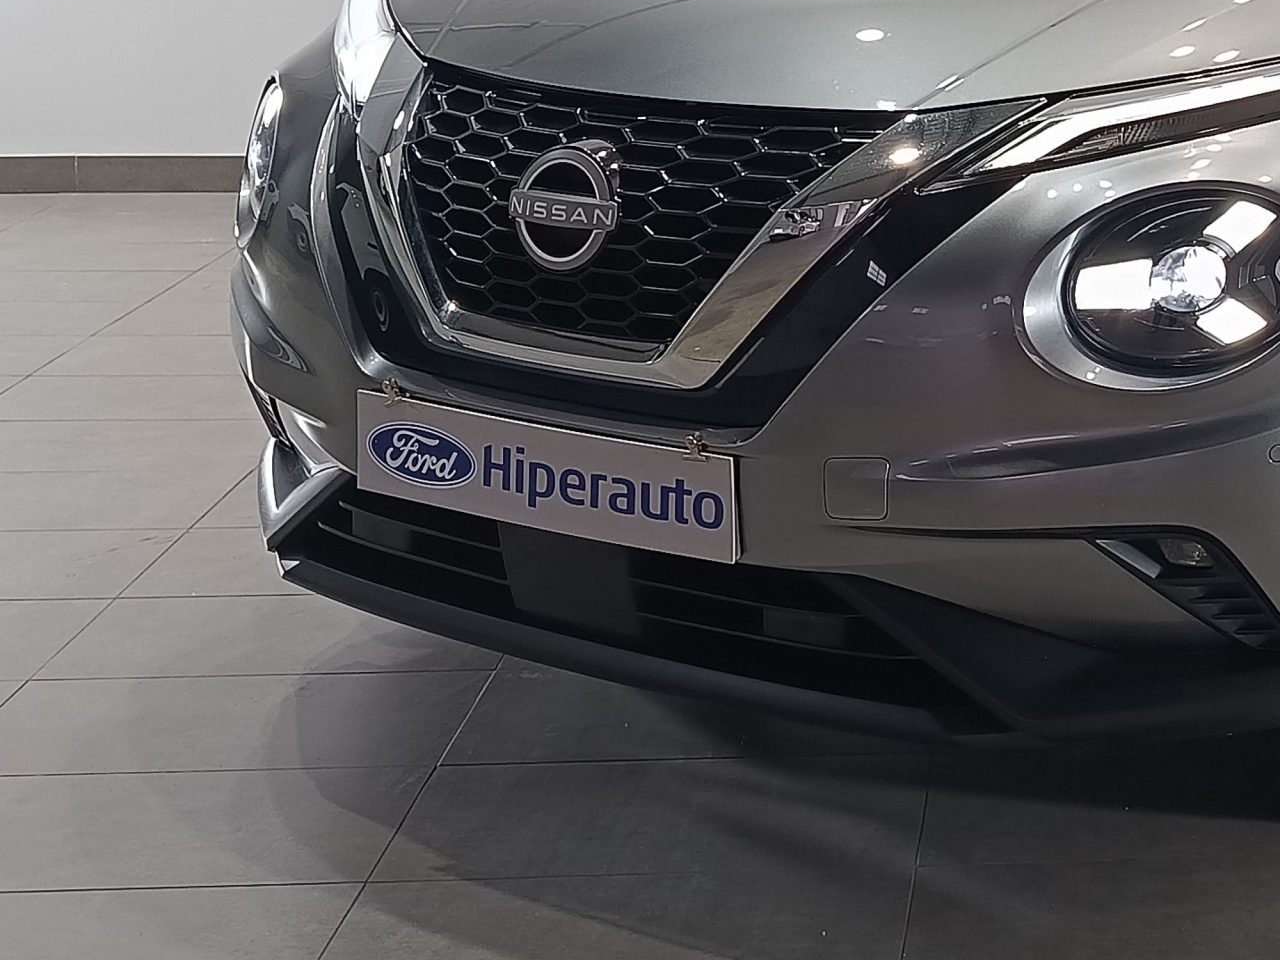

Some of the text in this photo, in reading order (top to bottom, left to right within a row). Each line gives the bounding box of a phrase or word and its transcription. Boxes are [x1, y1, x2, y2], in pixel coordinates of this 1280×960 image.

[510, 196, 613, 225] NISSAN
[385, 429, 724, 530] Ford Hiperauto
